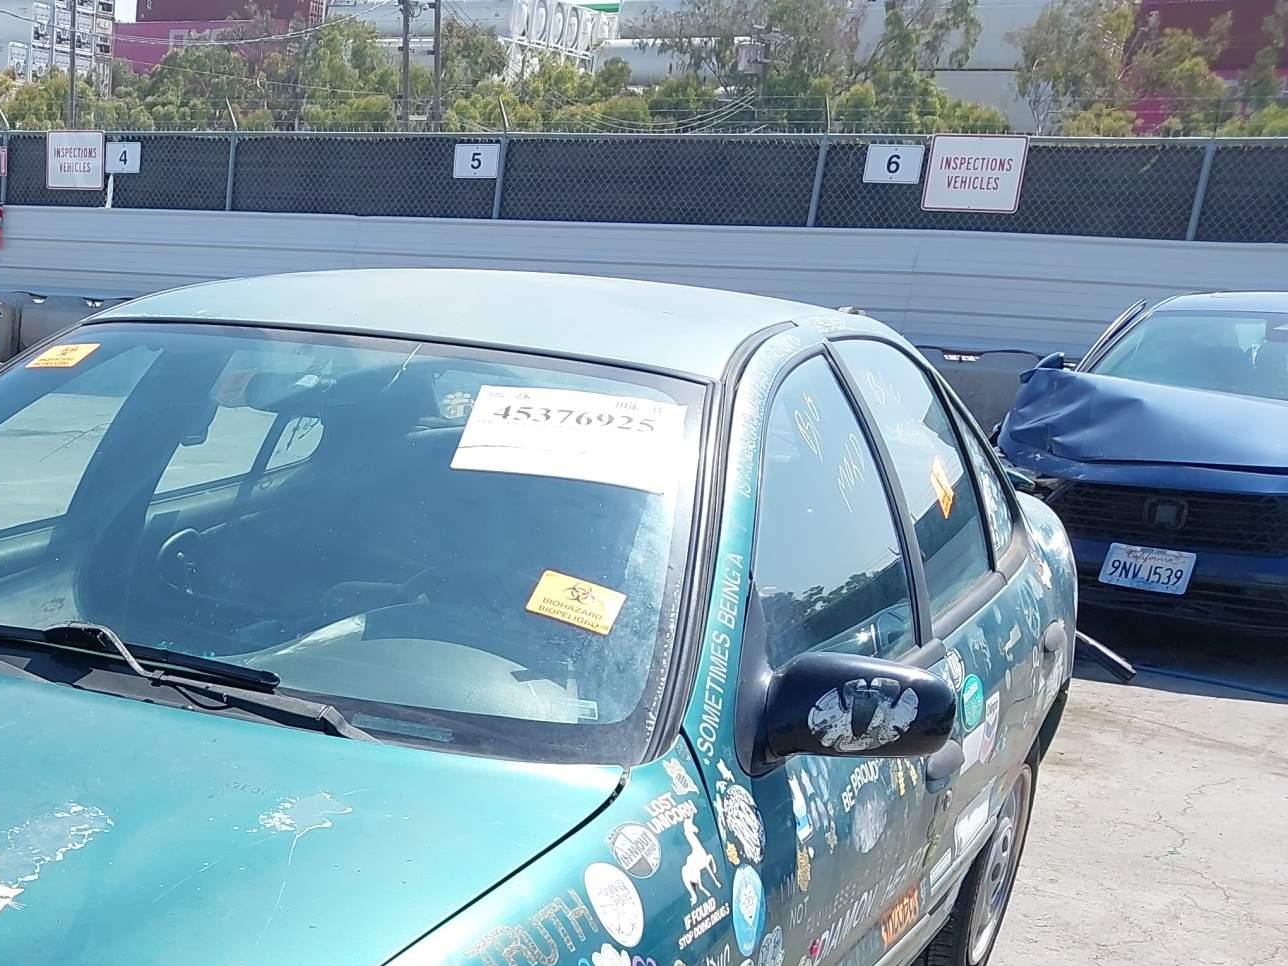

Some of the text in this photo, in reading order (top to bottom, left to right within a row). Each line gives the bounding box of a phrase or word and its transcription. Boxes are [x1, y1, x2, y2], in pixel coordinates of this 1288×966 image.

[53, 147, 97, 159] INSPECTIONS
[119, 150, 128, 166] 4
[471, 152, 482, 169] 5
[886, 154, 901, 174] 6
[939, 156, 1014, 172] INSPECTIONS
[59, 162, 91, 173] VEHICLES
[947, 175, 1000, 190] VEHICLES
[492, 405, 657, 432] 45376925
[1126, 549, 1175, 563] California
[538, 605, 600, 628] BIOPELIGRO
[542, 597, 603, 620] BIOHAZARD
[697, 630, 731, 757] SOMETIMES
[718, 570, 742, 630] BEING
[734, 550, 745, 567] A
[842, 759, 879, 813] BE PROUD
[644, 791, 676, 816] LOST
[646, 799, 698, 834] UNICORN
[683, 897, 717, 931] IF FOUND
[790, 895, 809, 930] NOT
[679, 902, 730, 950] STOP DOING DRUGS
